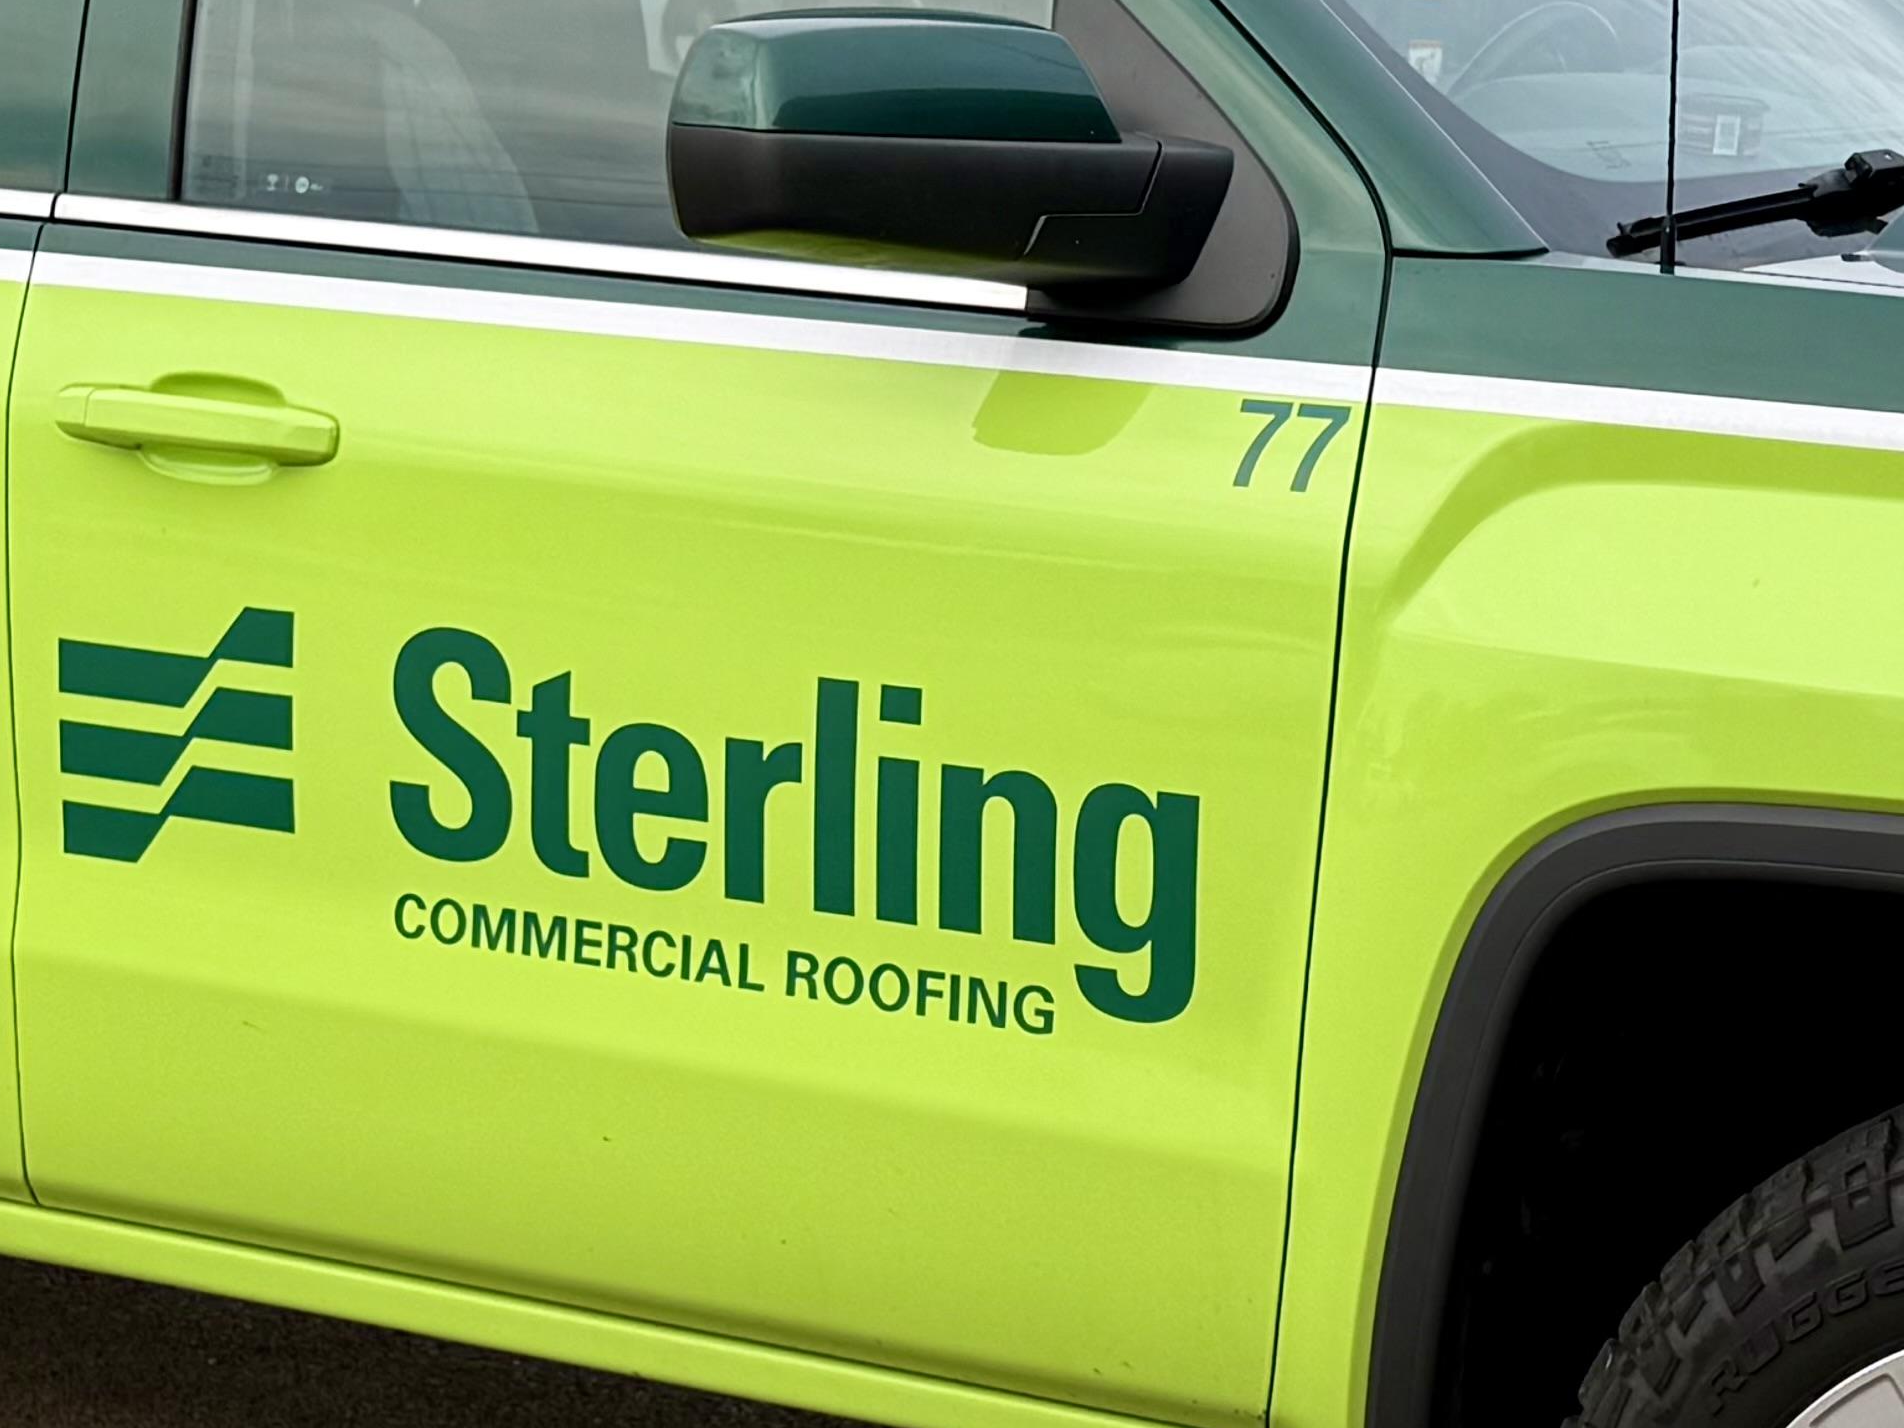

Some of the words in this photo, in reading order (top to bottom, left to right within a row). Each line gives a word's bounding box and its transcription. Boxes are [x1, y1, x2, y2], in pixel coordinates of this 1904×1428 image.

[1232, 398, 1352, 493] 77
[388, 625, 1201, 1025] Sterling
[393, 892, 766, 993] COMMERCIAL
[784, 949, 1056, 1036] ROOFING
